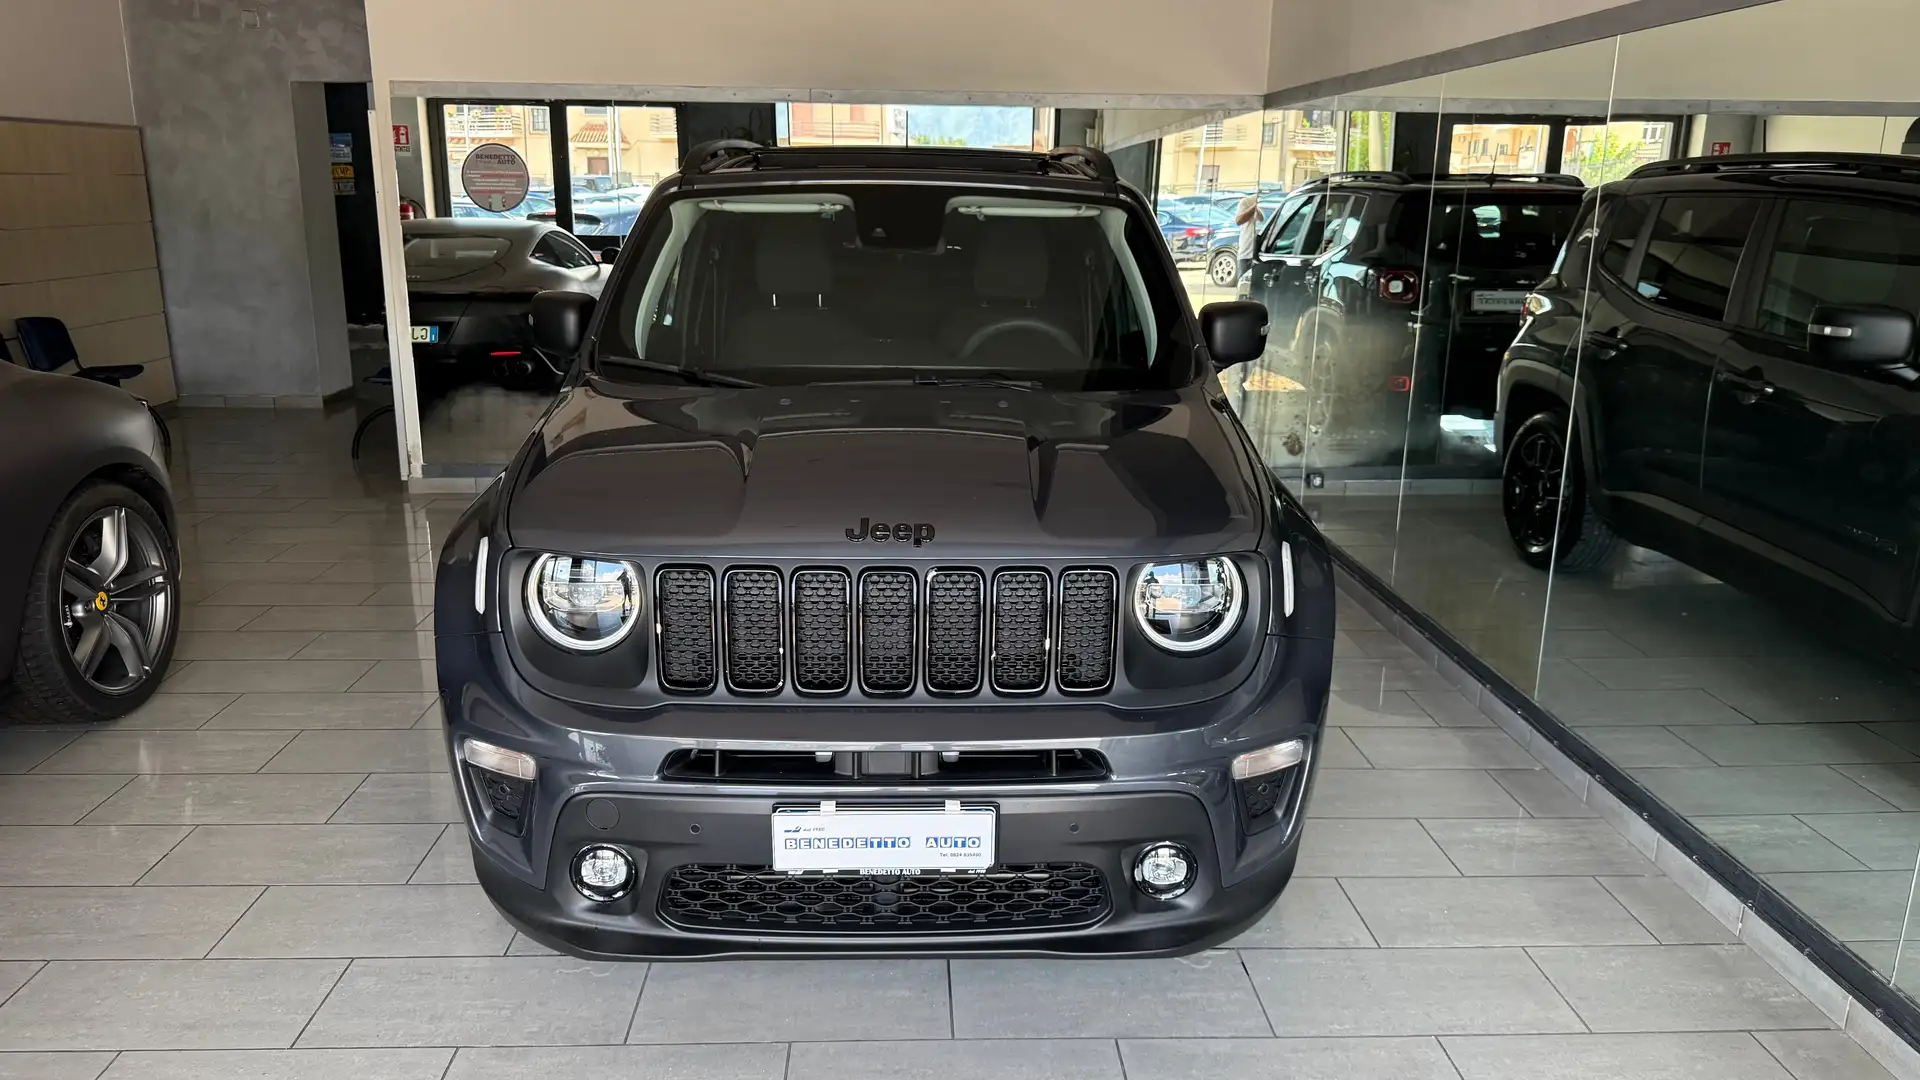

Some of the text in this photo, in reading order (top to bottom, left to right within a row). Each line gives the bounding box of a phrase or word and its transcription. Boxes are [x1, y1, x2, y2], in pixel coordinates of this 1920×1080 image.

[844, 517, 936, 549] Jeep
[784, 836, 981, 850] BENEDETTO AUTO
